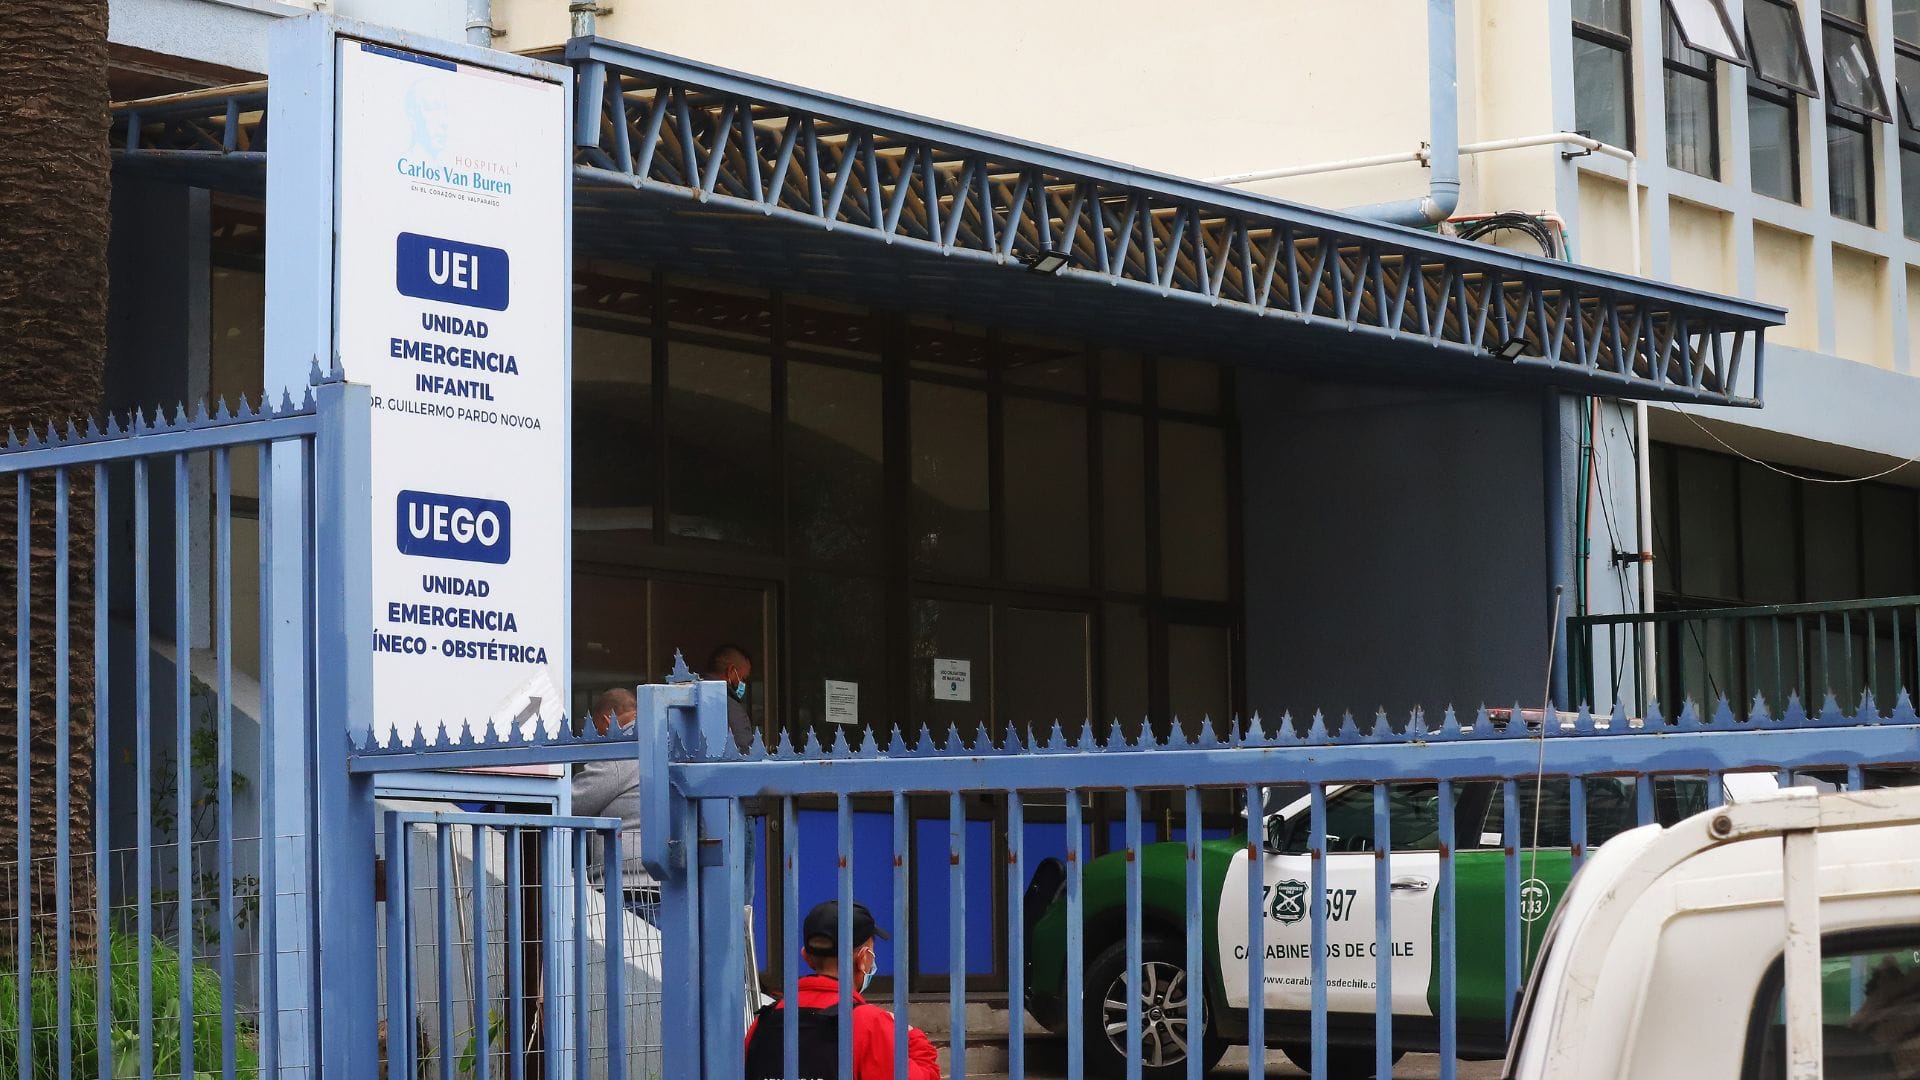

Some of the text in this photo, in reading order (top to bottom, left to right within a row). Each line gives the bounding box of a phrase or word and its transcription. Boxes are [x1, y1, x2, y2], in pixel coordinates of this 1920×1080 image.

[397, 158, 511, 195] Carlos Van Buren
[455, 155, 512, 175] HOSPITAL
[428, 248, 479, 291] UEI
[422, 312, 489, 339] UNIDAD
[390, 337, 519, 376] EMERGENCIA
[415, 373, 494, 401] INFANTIL
[387, 398, 455, 419] GUILLERMO
[457, 407, 498, 425] PARDO
[500, 413, 541, 430] NOVOA
[408, 502, 500, 547] UEGO
[422, 574, 490, 598] UNIDAD
[388, 602, 518, 633] EMERGENCIA
[372, 628, 427, 655] ÍNECO
[441, 638, 548, 665] OBSTÉTRICA
[1309, 888, 1357, 922] 597
[1520, 900, 1542, 914] 133
[1234, 942, 1414, 960] CABINES DE CILE
